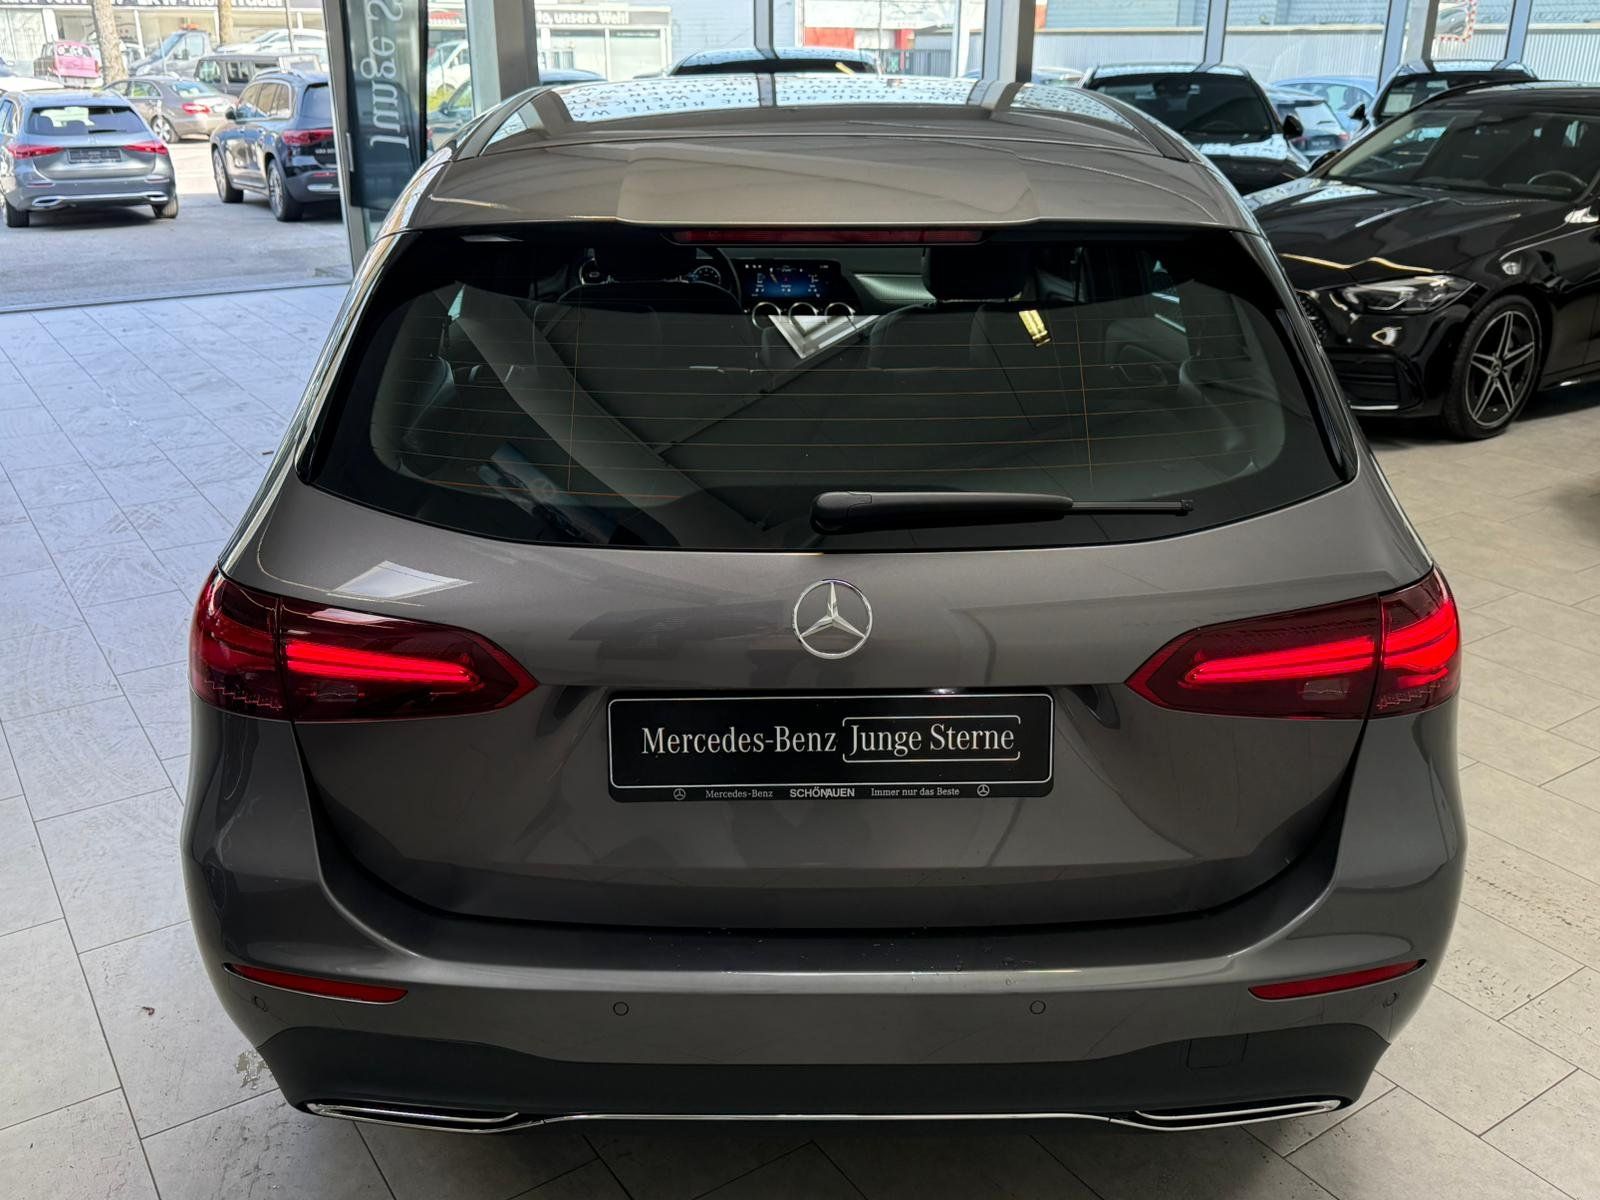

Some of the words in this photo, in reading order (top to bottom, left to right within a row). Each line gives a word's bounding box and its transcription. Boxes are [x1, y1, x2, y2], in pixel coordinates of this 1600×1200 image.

[641, 725, 837, 754] Mercedes-Benz
[850, 724, 922, 757] Junge
[930, 723, 1014, 751] Sterne
[705, 789, 773, 799] Mercedes-Benz
[789, 786, 855, 798] SCHÖNAUEN
[871, 788, 900, 797] Immer
[902, 788, 918, 797] nur
[919, 787, 935, 797] das
[937, 786, 960, 797] Beste
